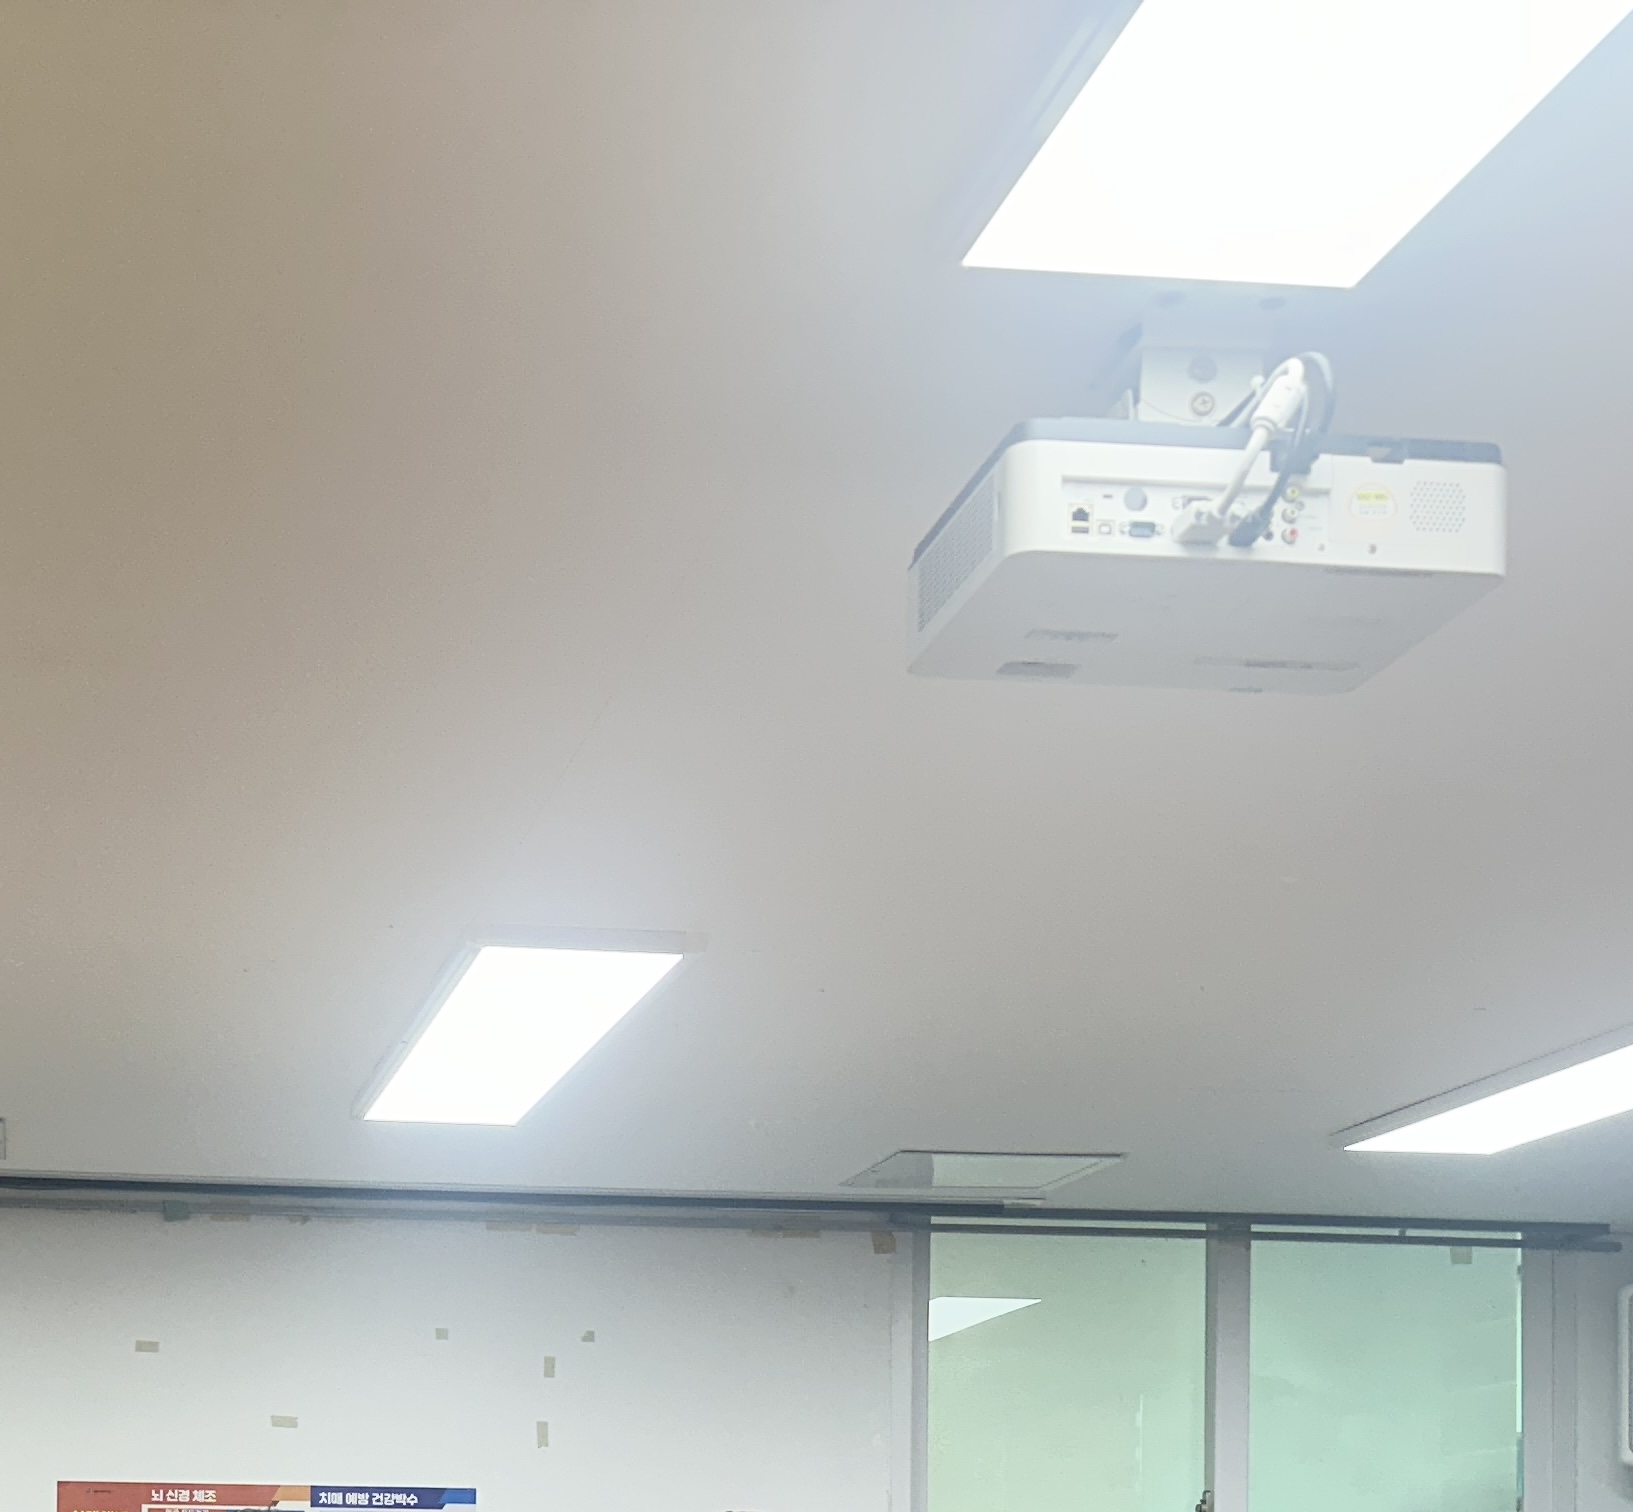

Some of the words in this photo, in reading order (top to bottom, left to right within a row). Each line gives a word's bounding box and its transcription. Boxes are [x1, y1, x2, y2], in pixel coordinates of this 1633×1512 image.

[151, 1489, 163, 1502] 뇌
[166, 1489, 190, 1502] 신경
[192, 1489, 217, 1502] 체조
[318, 1491, 343, 1505] 치매
[345, 1492, 369, 1506] 예방
[371, 1492, 419, 1506] 건강박수
